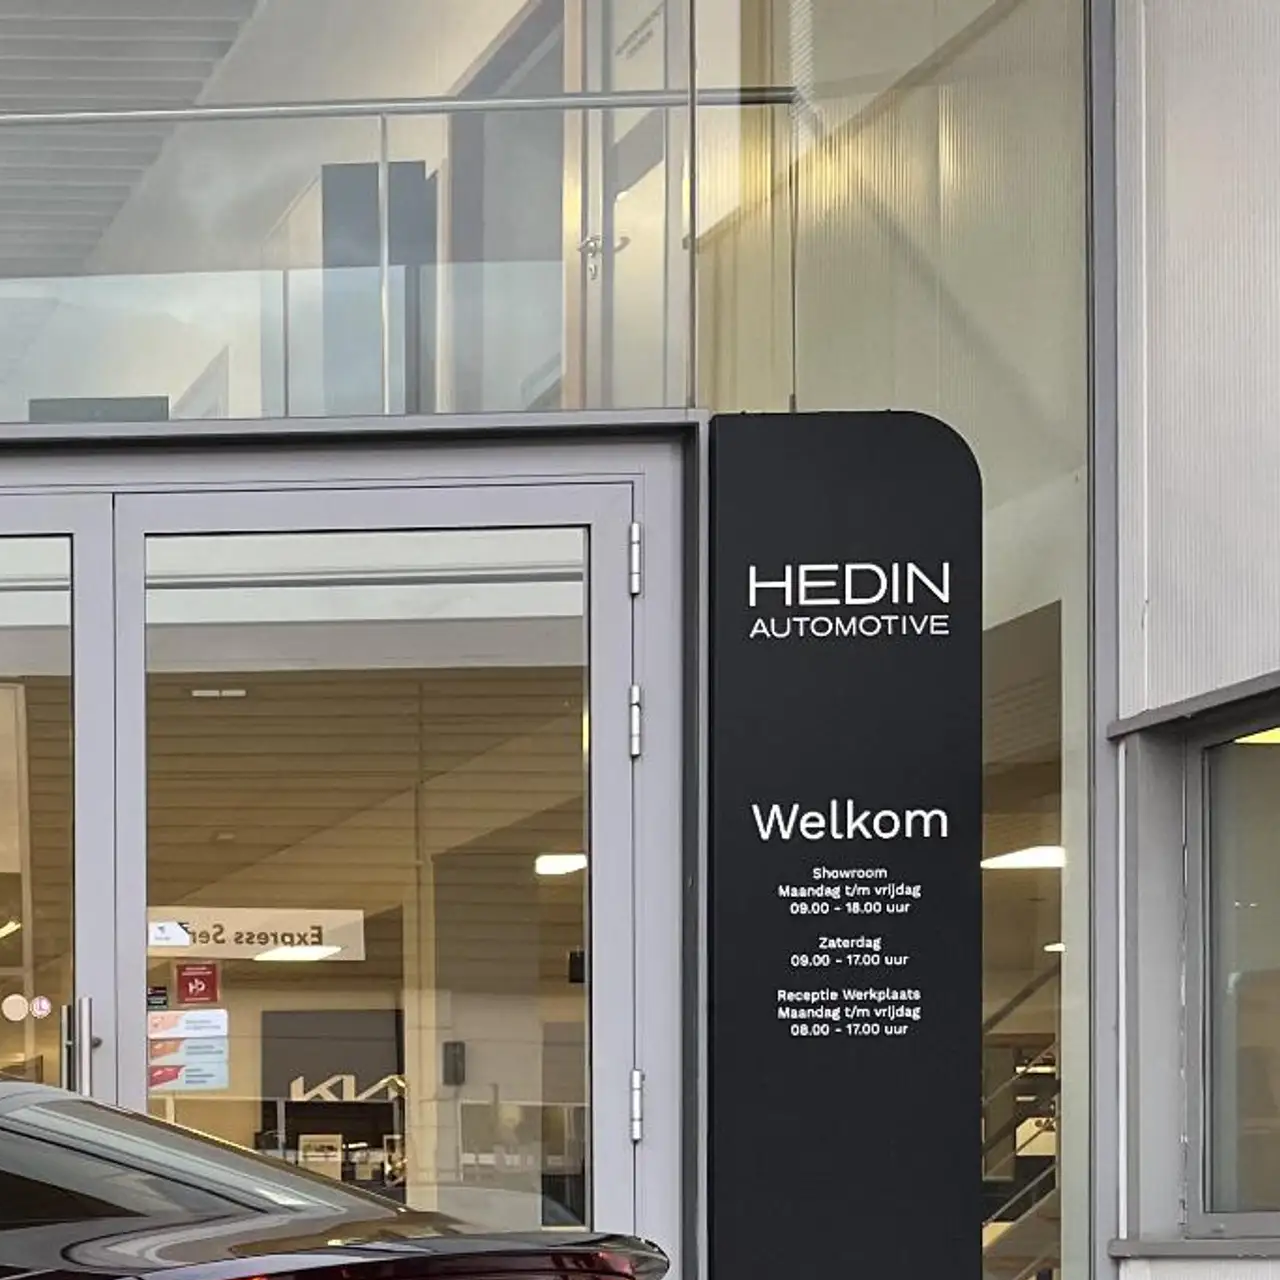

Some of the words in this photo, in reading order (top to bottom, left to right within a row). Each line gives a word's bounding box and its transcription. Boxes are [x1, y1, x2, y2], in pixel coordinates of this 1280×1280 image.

[749, 562, 949, 606] HEDIN
[749, 614, 949, 639] AUTOMOTIVE
[751, 798, 948, 841] Welkom
[812, 865, 888, 880] Showroom
[777, 883, 841, 899] Maandag
[844, 884, 871, 897] t/m
[873, 883, 922, 899] vrijdag
[886, 902, 911, 914] uur
[818, 935, 882, 951] Zaterdag
[790, 953, 831, 967] 09.00
[846, 953, 881, 966] 17.00
[884, 955, 910, 966] uur
[777, 987, 839, 1004] Receptie
[841, 986, 922, 1004] Werkplaats
[777, 1005, 841, 1021] Maandag
[843, 1005, 871, 1019] t/m
[873, 1004, 922, 1021] vrijdag
[790, 1023, 830, 1037] 08.00
[845, 1022, 881, 1036] 17.00
[884, 1024, 909, 1036] uur
